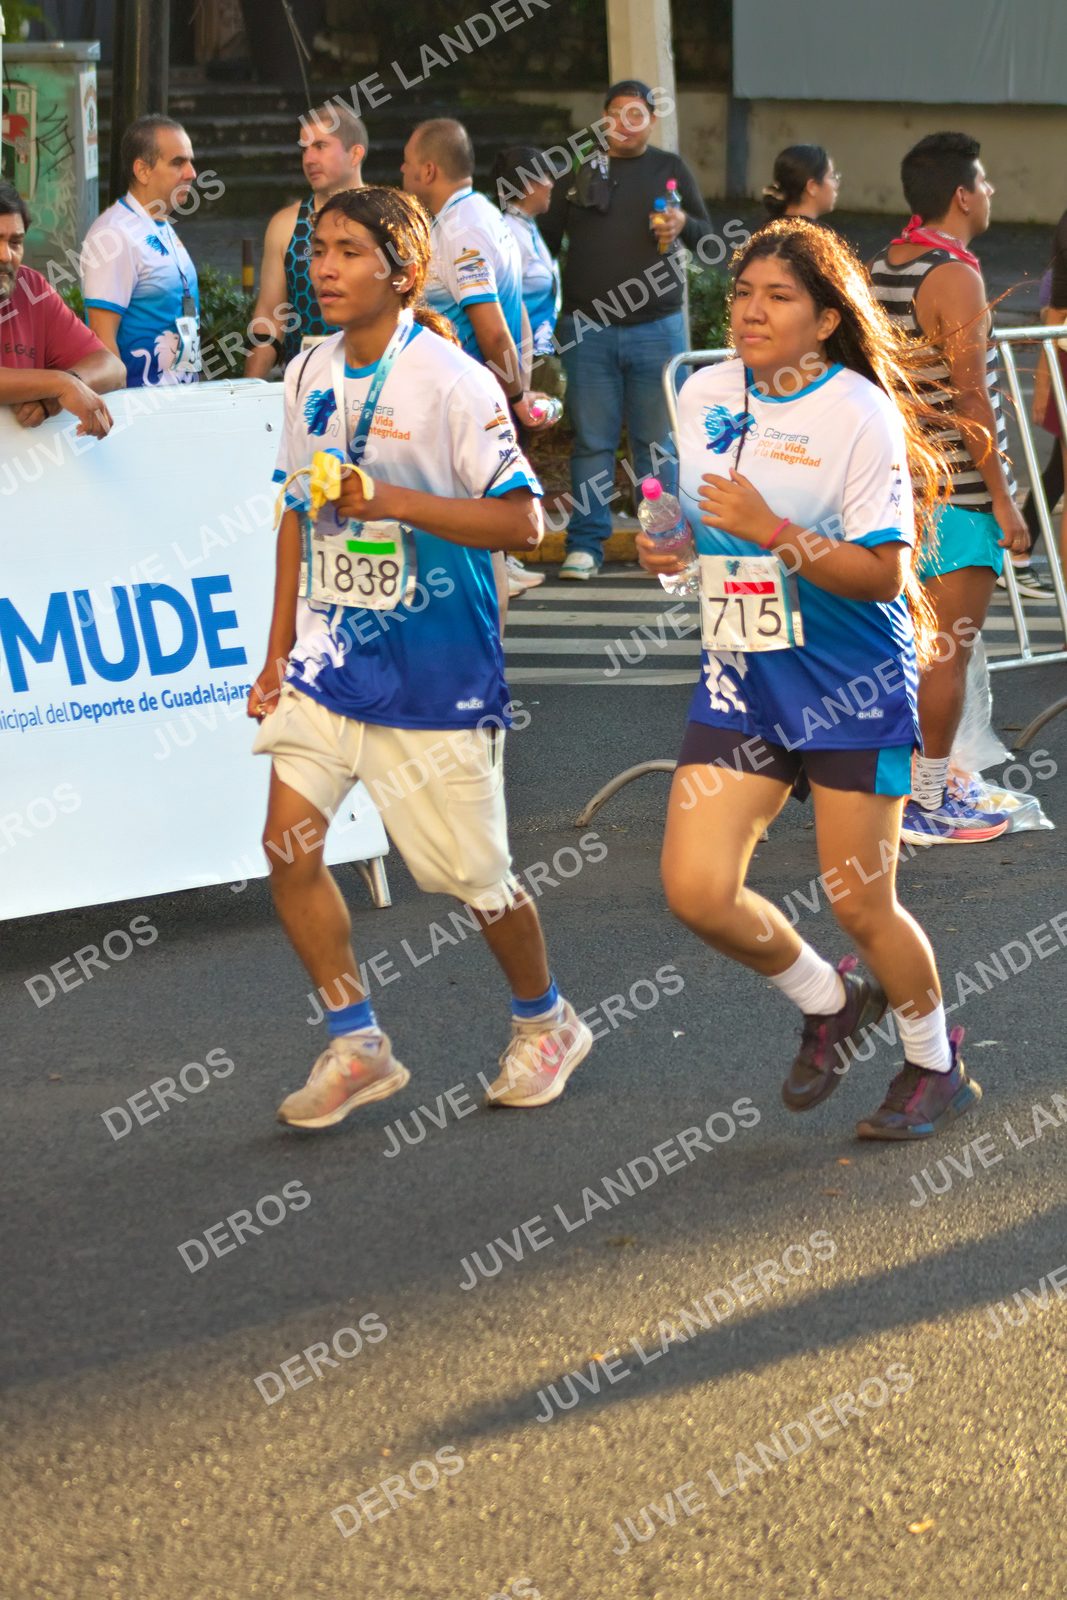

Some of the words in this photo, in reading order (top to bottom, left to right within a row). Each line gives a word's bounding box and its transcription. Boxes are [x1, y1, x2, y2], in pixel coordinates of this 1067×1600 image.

[352, 400, 394, 416] Caera
[375, 415, 394, 427] Vida
[369, 427, 411, 440] ntegridad
[764, 428, 809, 444] Carrera
[757, 440, 774, 449] por
[776, 441, 783, 449] la
[784, 442, 807, 455] Vida
[760, 448, 769, 457] la
[770, 450, 822, 467] Integridad
[317, 550, 400, 597] 1838
[0, 575, 247, 693] MUDE
[0, 704, 43, 732] icipal
[47, 702, 70, 724] del
[70, 697, 136, 723] Deporte
[140, 692, 158, 712] de
[161, 681, 251, 707] Guadalajara
